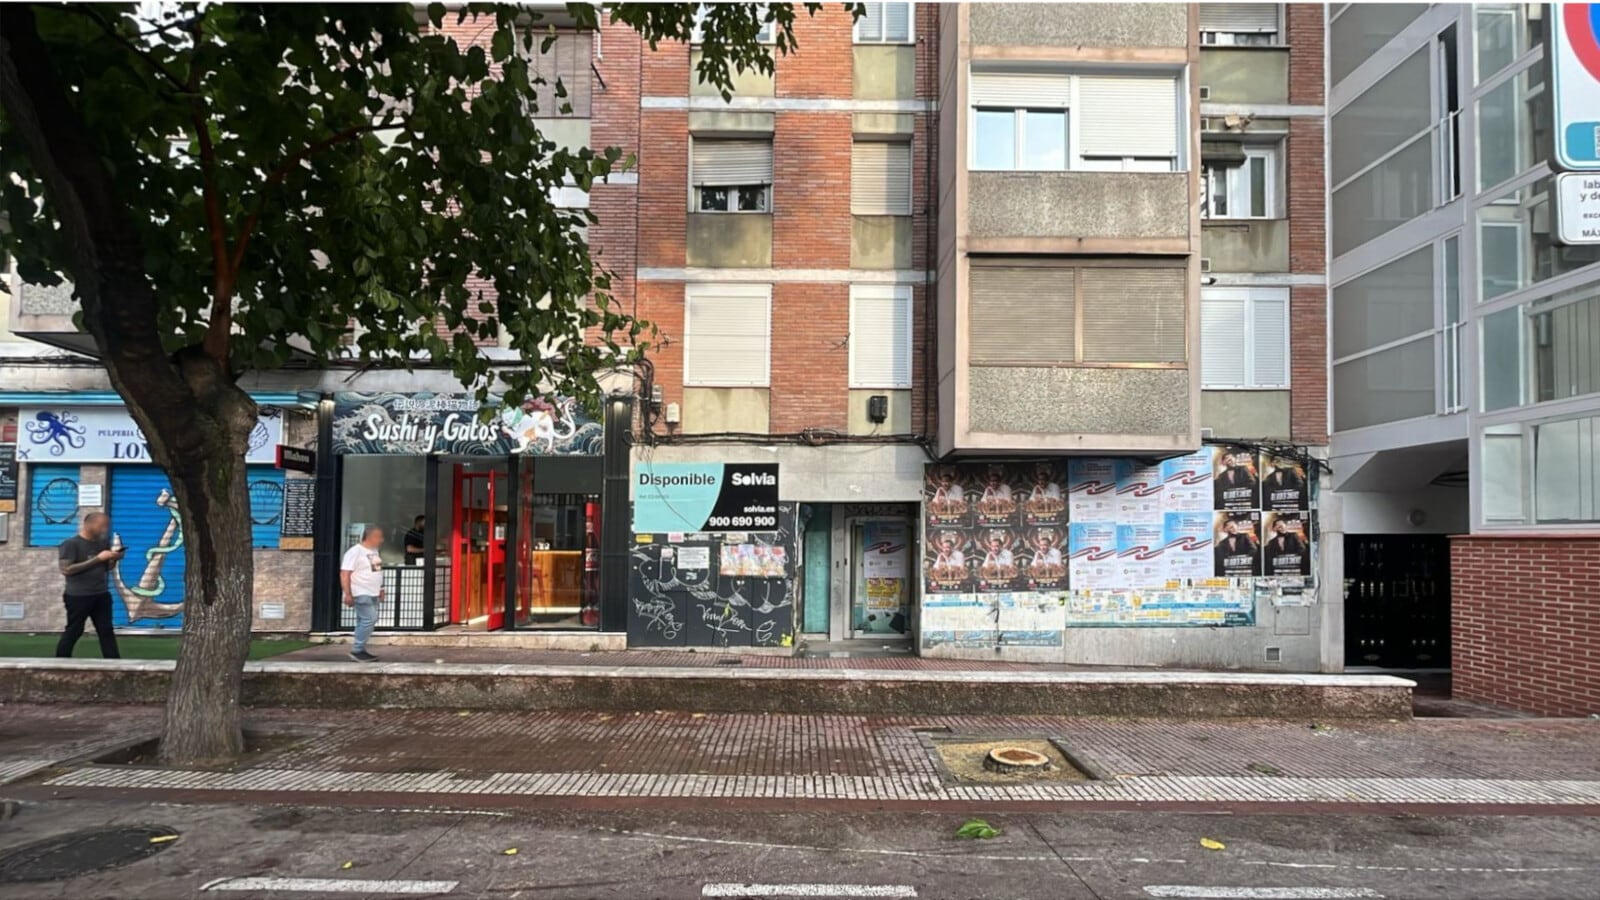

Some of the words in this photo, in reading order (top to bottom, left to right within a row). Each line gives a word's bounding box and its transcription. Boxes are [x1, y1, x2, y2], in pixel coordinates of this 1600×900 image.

[1580, 192, 1587, 202] y
[1582, 228, 1600, 237] MÁ
[363, 413, 419, 440] Sushi
[422, 424, 437, 452] y
[443, 413, 499, 441] Gatos
[639, 473, 715, 487] Disponible
[731, 472, 776, 486] Solvia
[743, 505, 776, 513] solvia.es
[709, 516, 730, 527] 900
[731, 516, 753, 527] 690
[754, 516, 776, 527] 900
